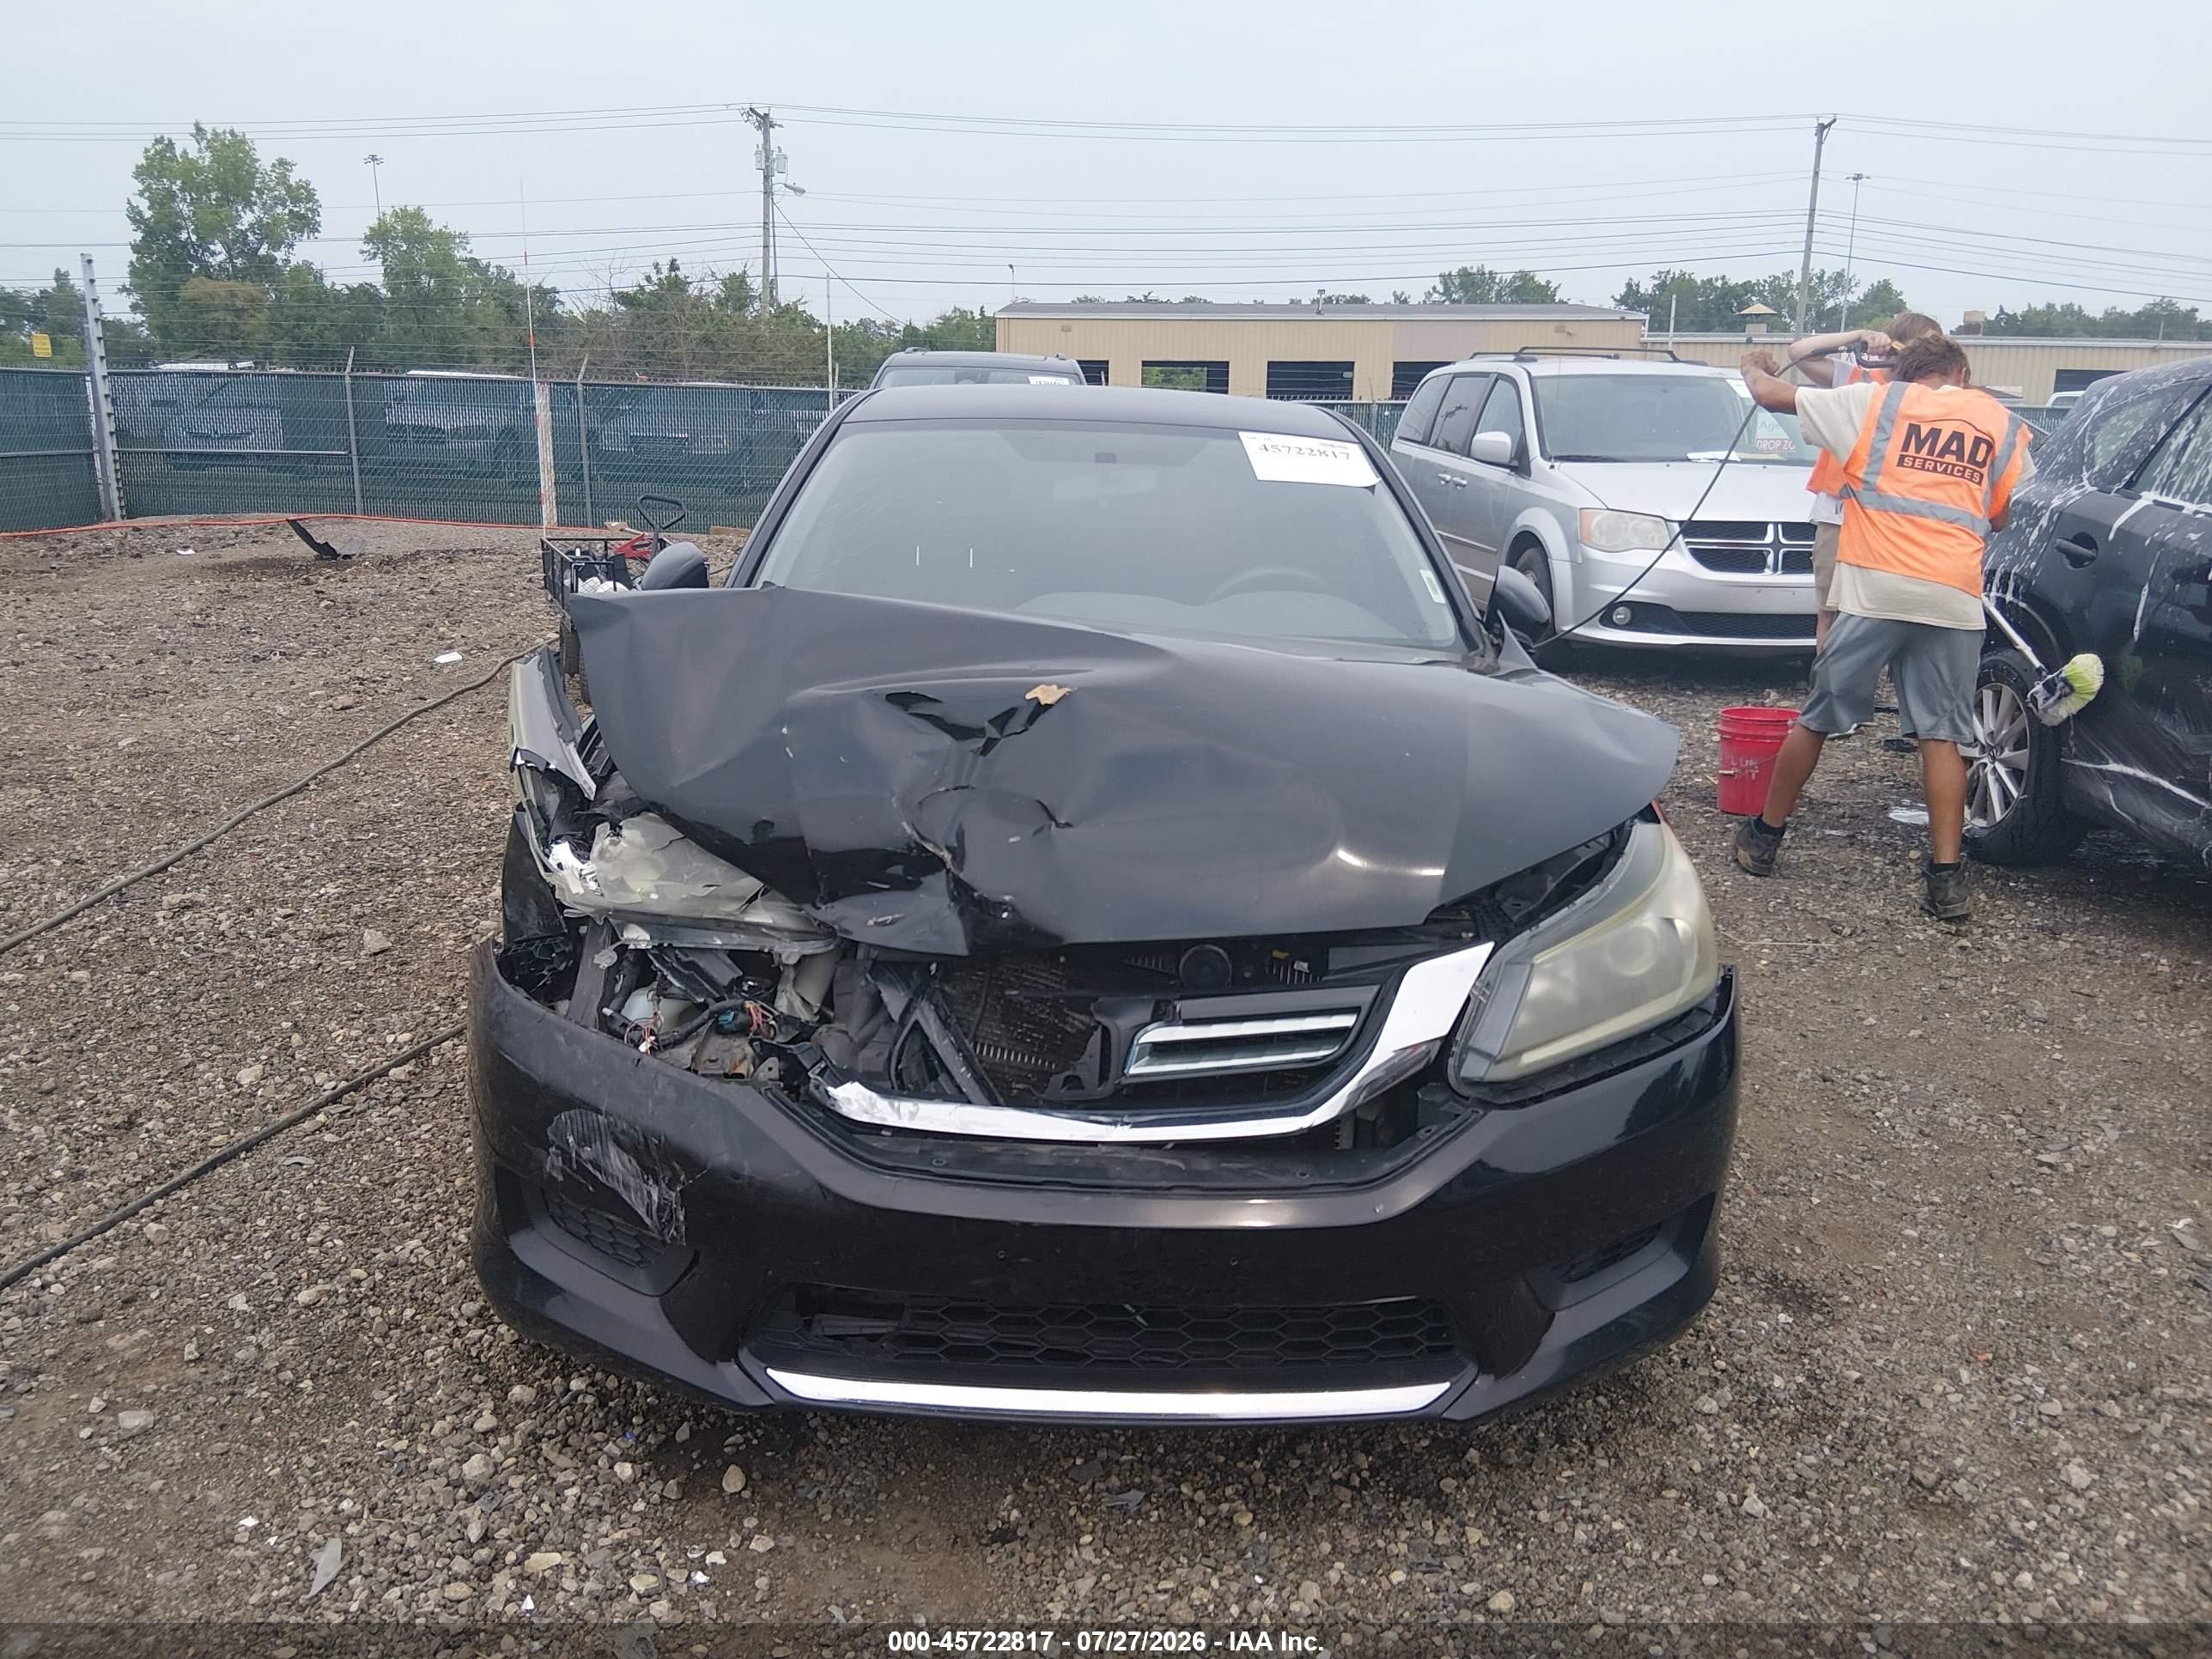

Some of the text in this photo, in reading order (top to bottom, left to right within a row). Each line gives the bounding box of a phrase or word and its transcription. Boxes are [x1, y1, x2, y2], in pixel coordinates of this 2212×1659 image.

[1258, 443, 1350, 461] 45722817
[1756, 439, 1782, 450] DROP
[1900, 422, 1994, 470] MAD
[1902, 456, 1981, 483] SERVICES
